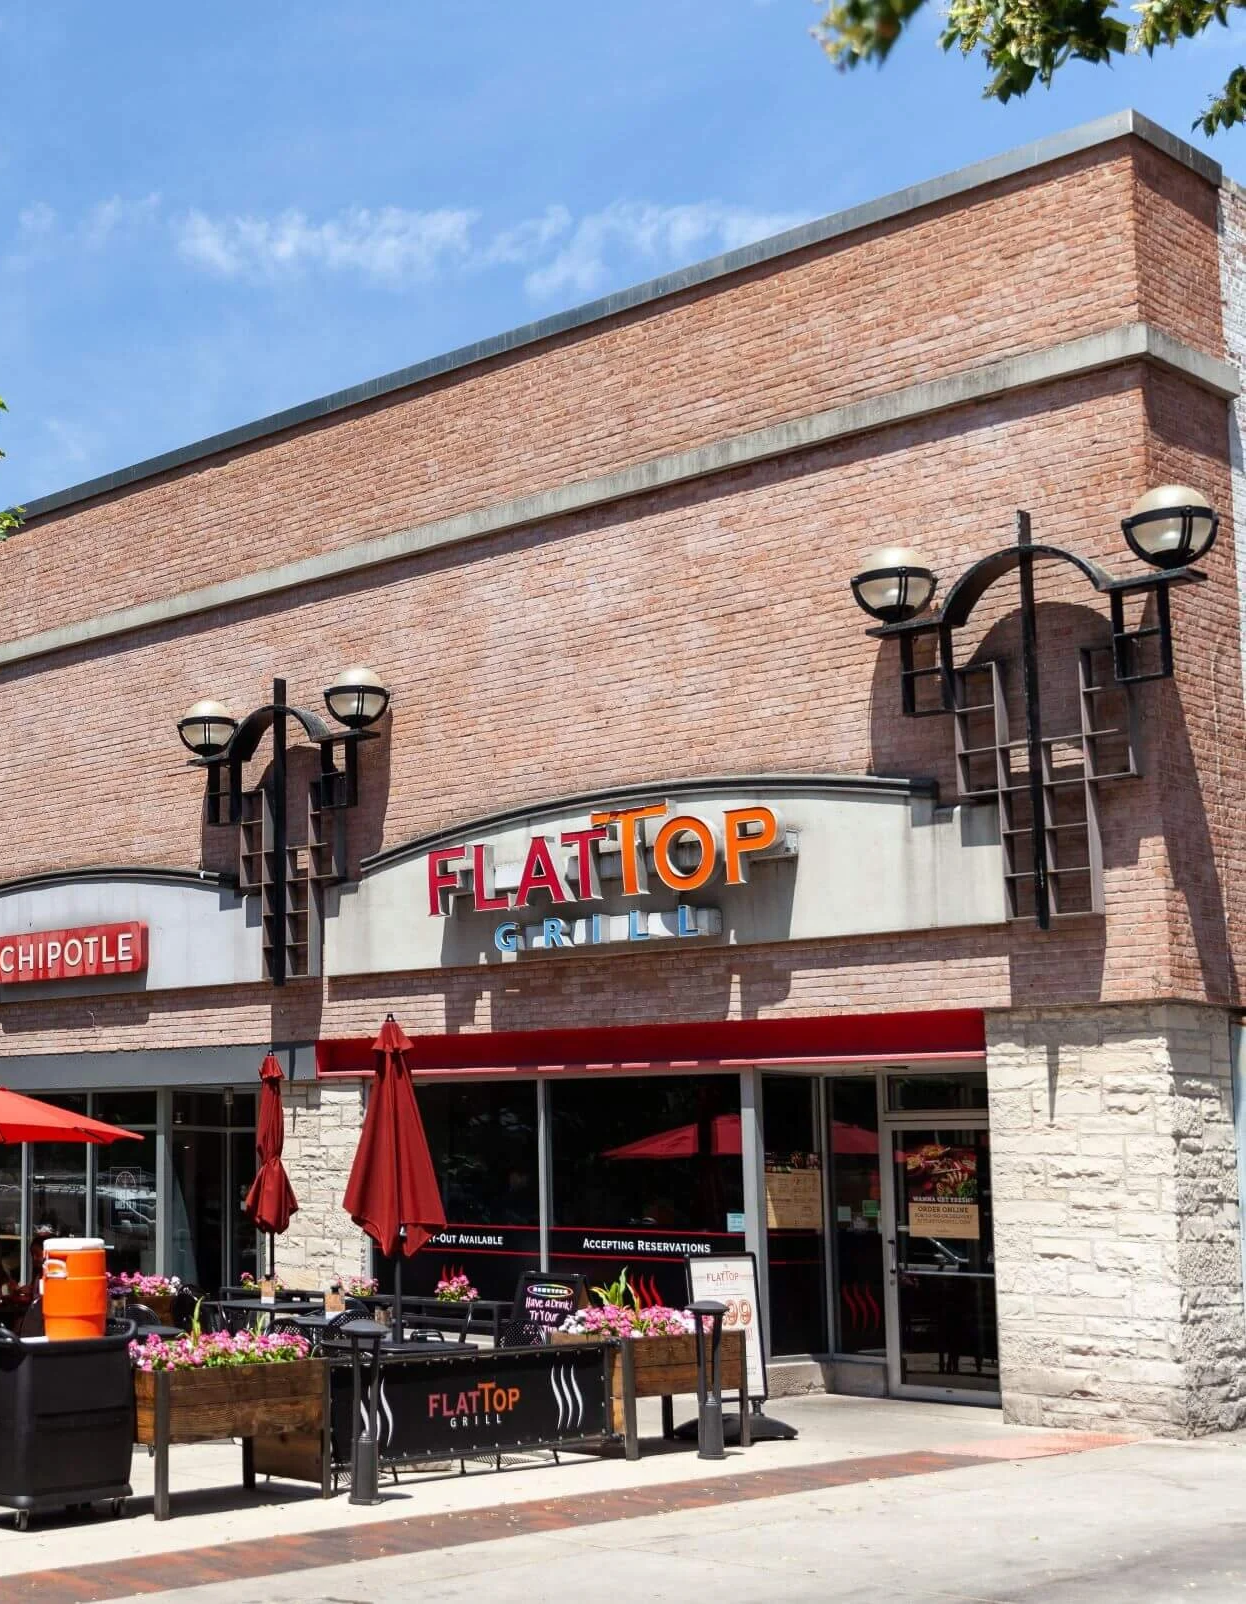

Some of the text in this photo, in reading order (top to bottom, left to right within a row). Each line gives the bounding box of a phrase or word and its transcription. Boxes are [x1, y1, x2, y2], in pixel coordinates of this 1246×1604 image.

[494, 904, 700, 952] GRILL
[0, 932, 134, 973] CHIPOTLE
[458, 1234, 503, 1245] AVAILABLE
[583, 1238, 711, 1253] ACCEPTING RESERVATIONS
[450, 1413, 502, 1428] GRILL
